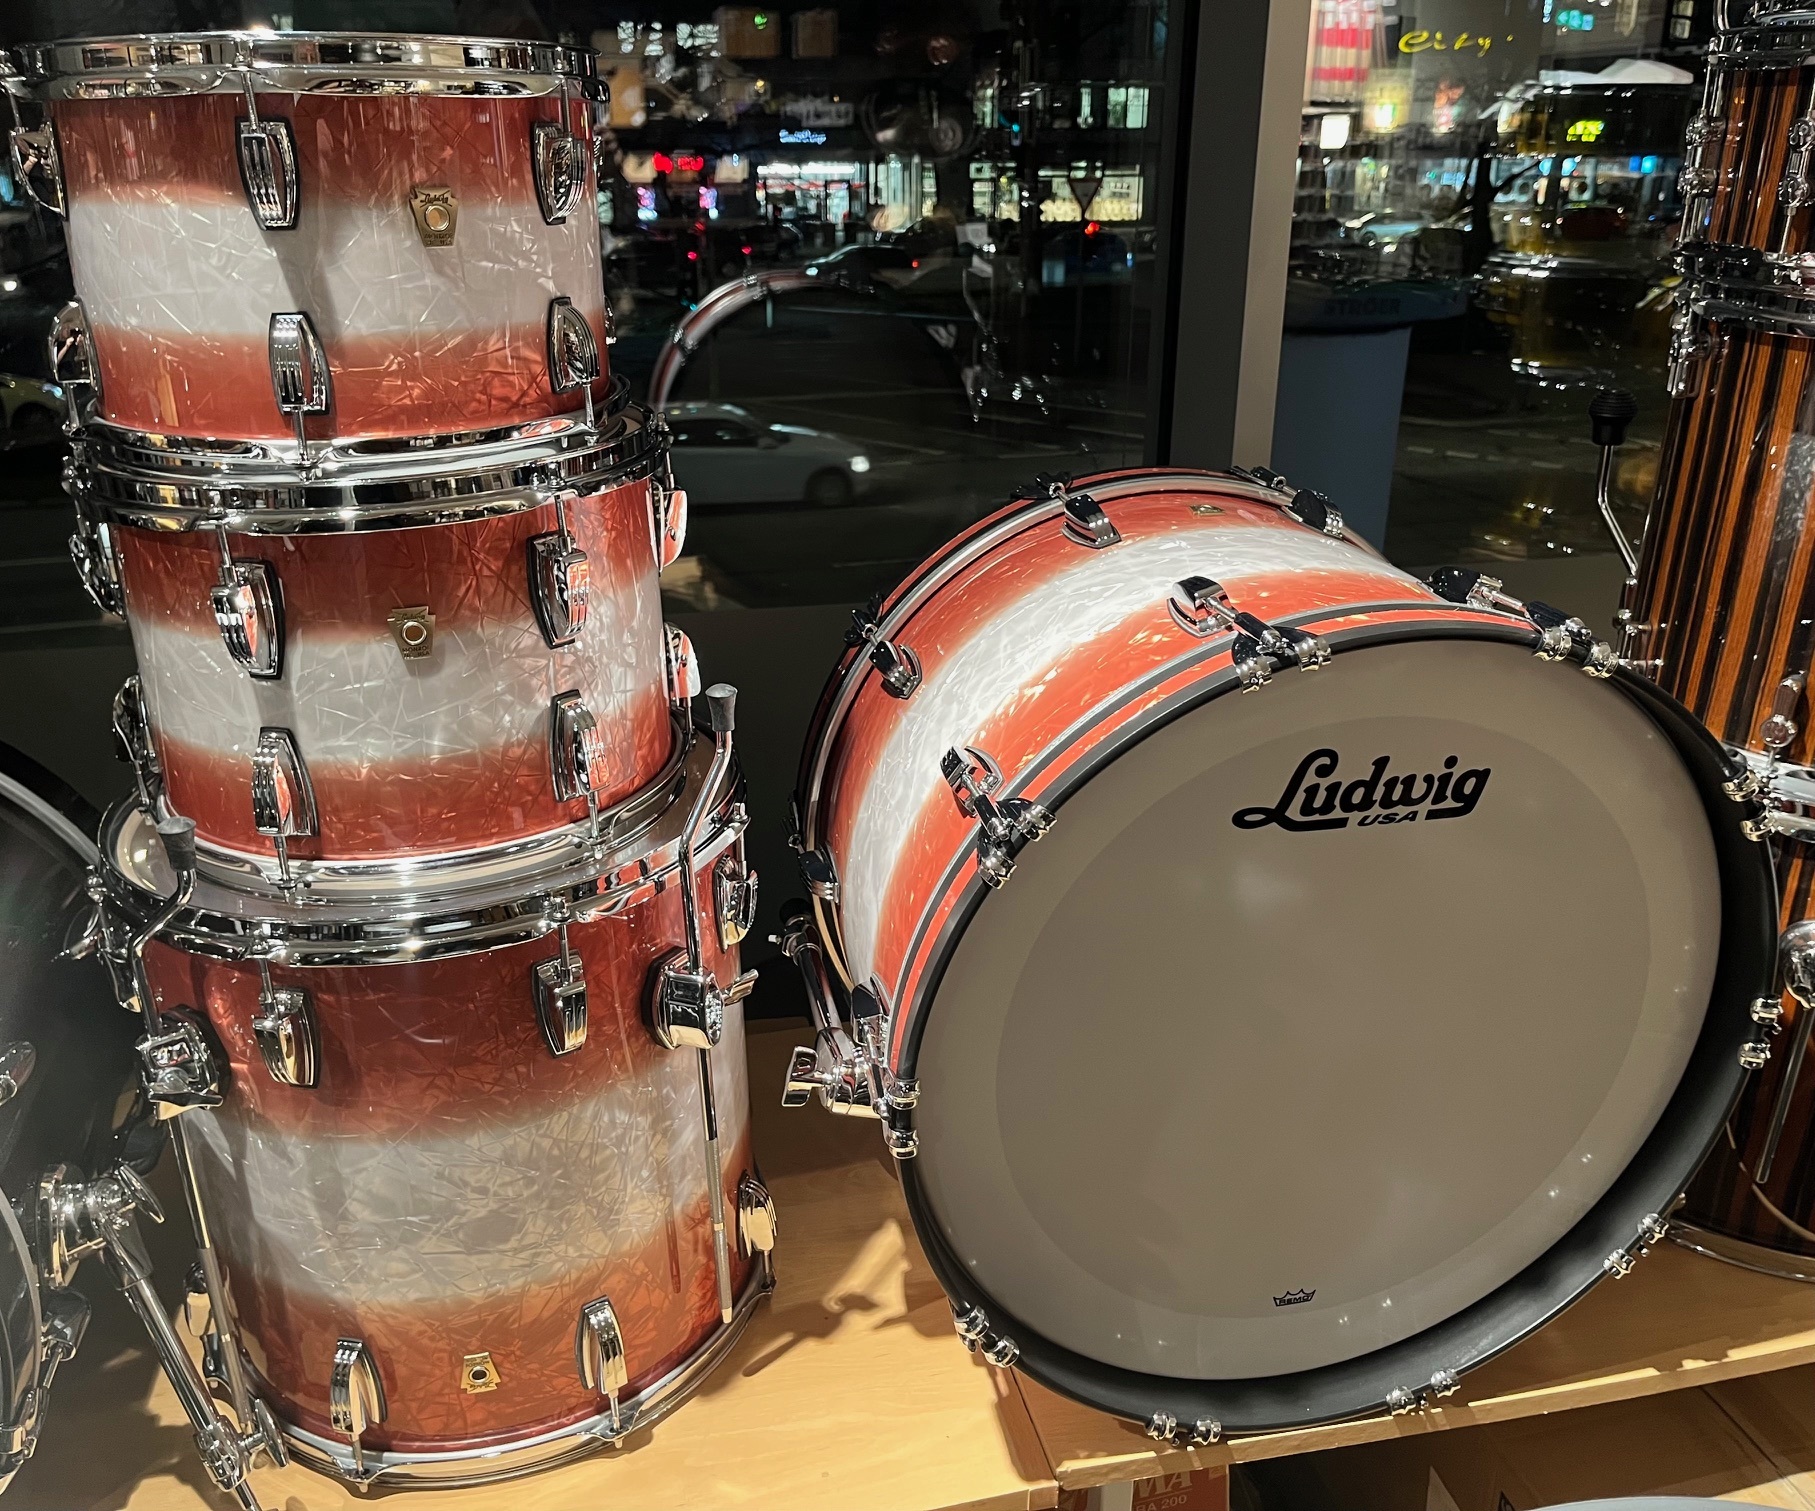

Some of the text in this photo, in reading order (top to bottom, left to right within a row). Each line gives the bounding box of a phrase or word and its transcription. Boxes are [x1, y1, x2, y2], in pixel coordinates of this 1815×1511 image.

[1231, 748, 1492, 832] Ludwig
[1357, 810, 1419, 827] USA
[1278, 1294, 1311, 1305] REMO
[1161, 1494, 1187, 1510] 200
